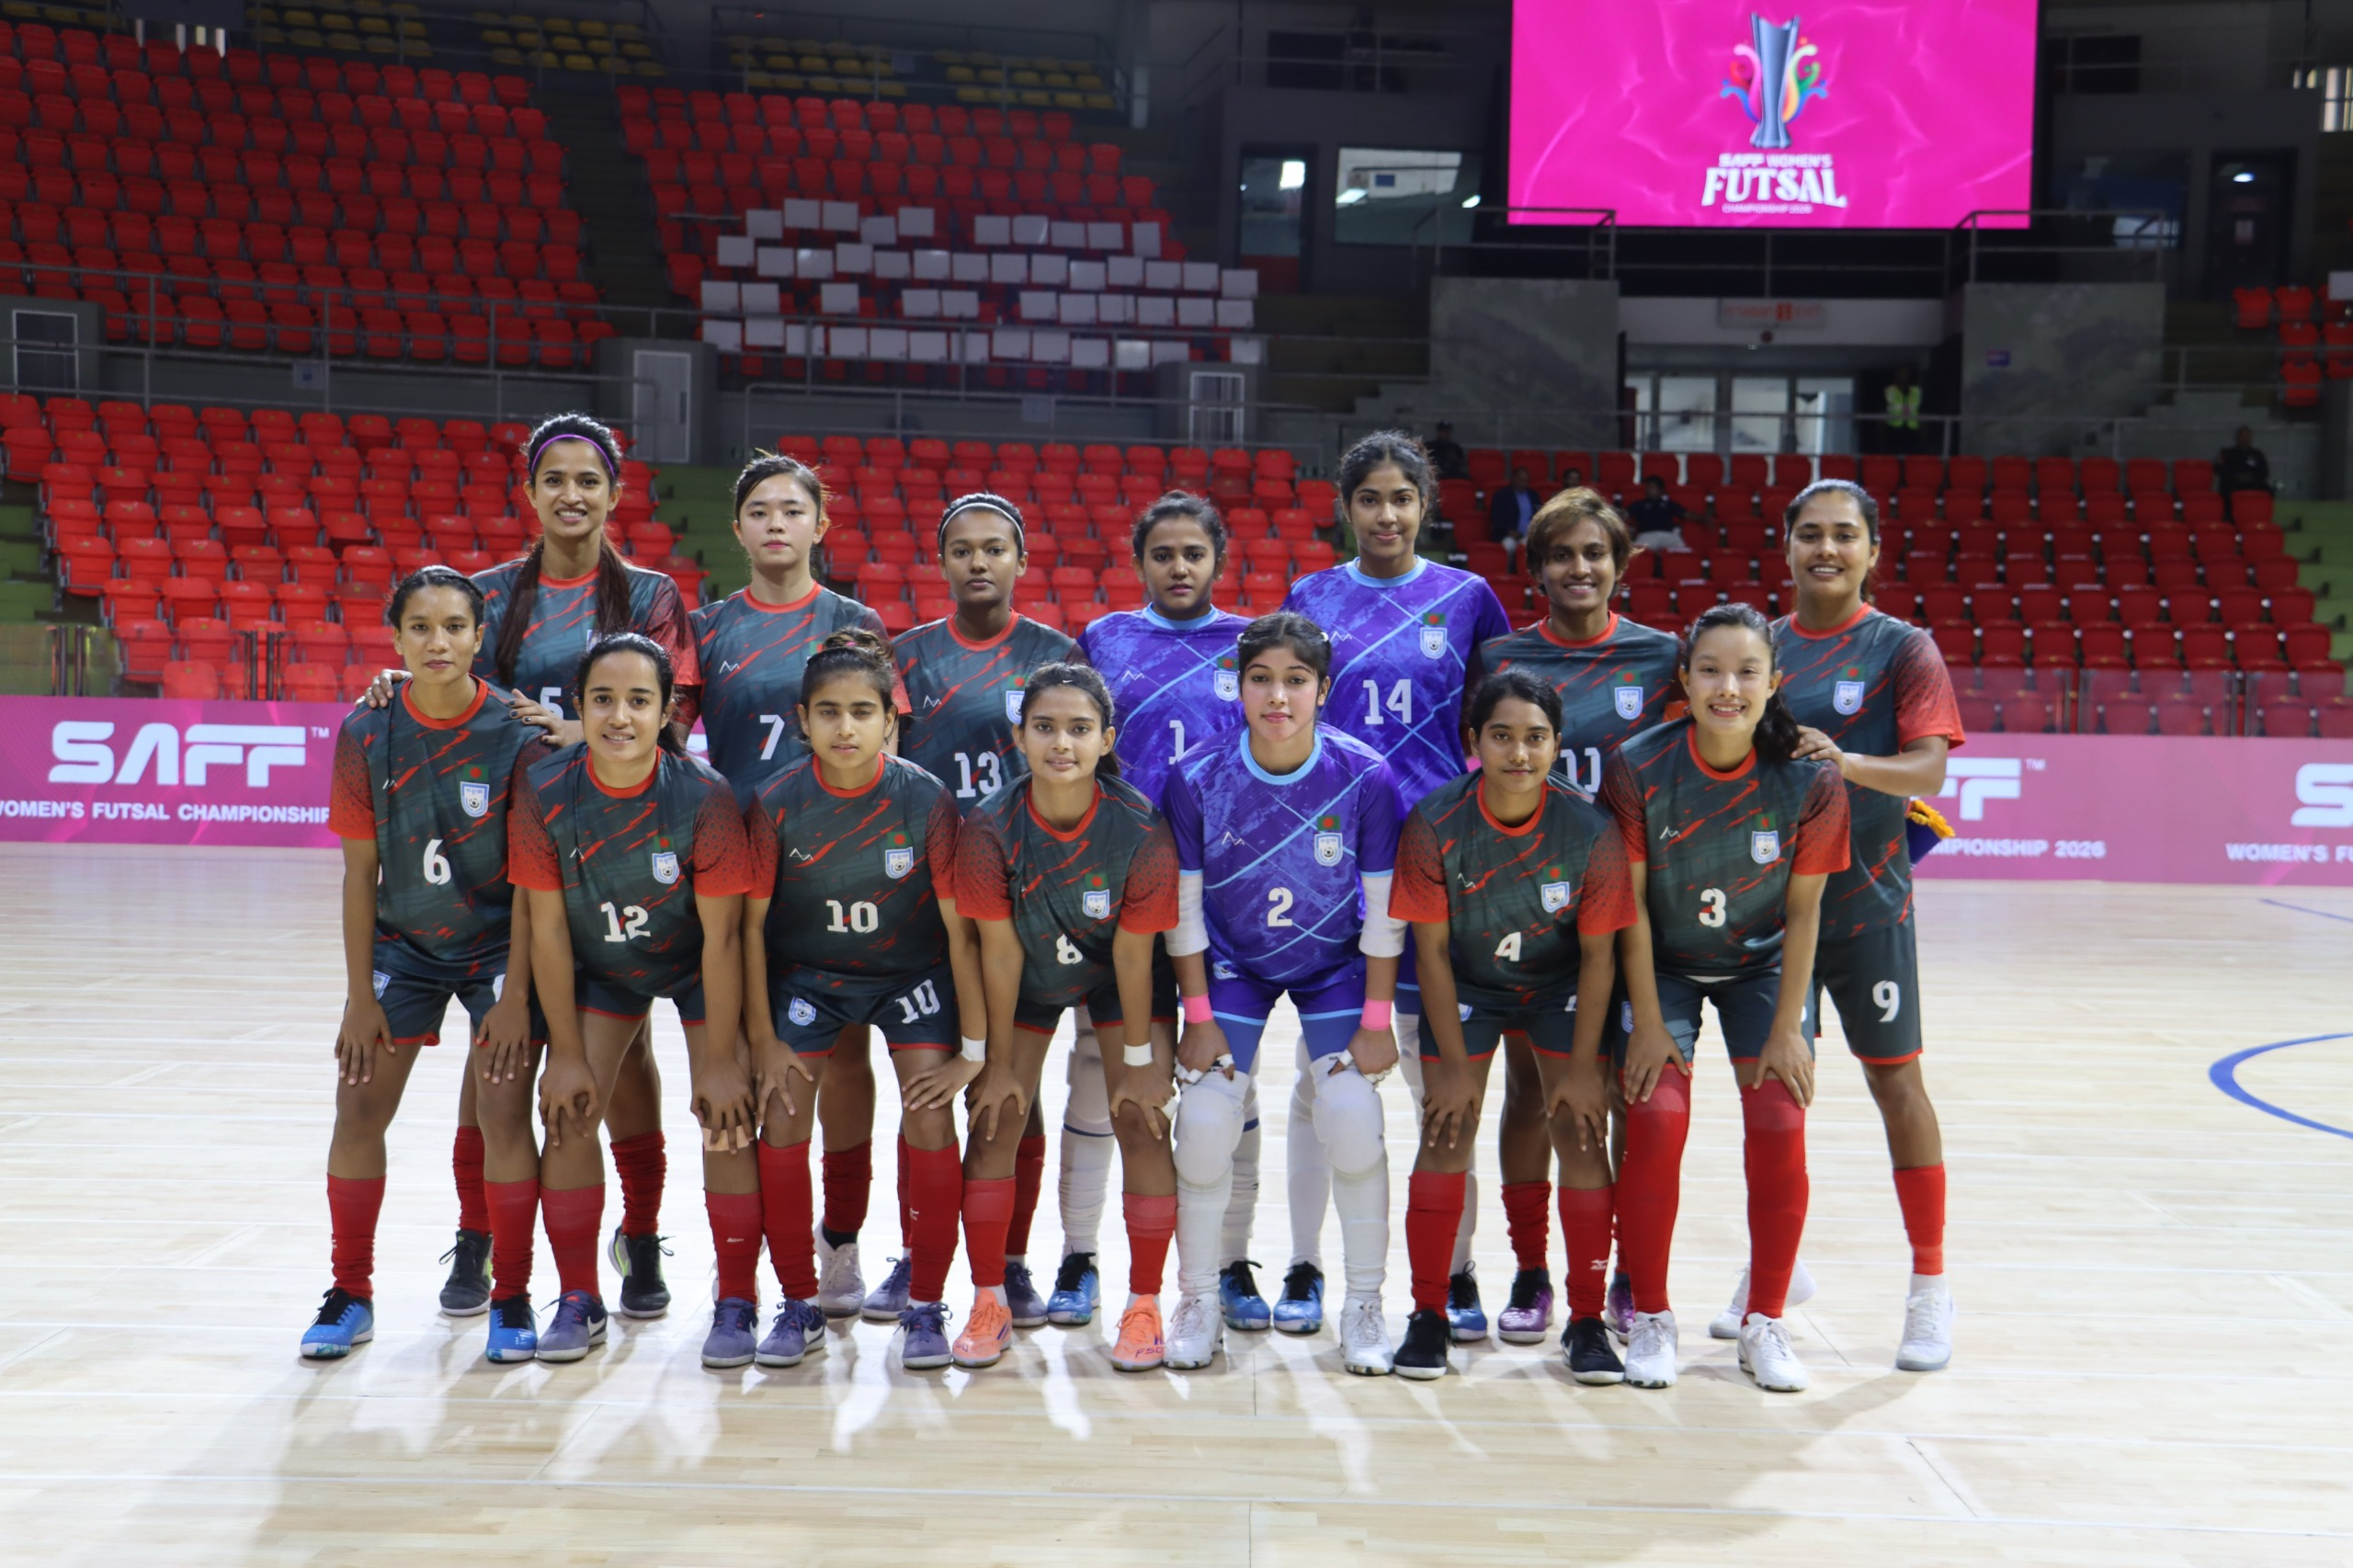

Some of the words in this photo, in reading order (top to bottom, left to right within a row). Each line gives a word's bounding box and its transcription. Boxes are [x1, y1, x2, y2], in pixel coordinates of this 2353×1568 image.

[1767, 154, 1833, 167] WOMEN'S
[1701, 167, 1847, 208] FUTSAL
[540, 687, 564, 720] 5
[1362, 678, 1412, 725] 14
[49, 721, 306, 787] SAFF
[759, 714, 785, 760] 7
[1168, 720, 1185, 765] 1
[954, 751, 1001, 798] 13
[92, 802, 170, 821] FUTSAL
[423, 838, 451, 886] 6
[2054, 840, 2106, 858] 2026
[2225, 843, 2329, 863] WOMEN'S
[600, 901, 652, 943] 12
[825, 899, 879, 934] 10
[1267, 887, 1293, 927] 2
[1699, 888, 1727, 928] 3
[1056, 933, 1084, 965] 8
[1494, 931, 1522, 961] 4
[895, 978, 941, 1025] 10
[1871, 980, 1901, 1023] 9
